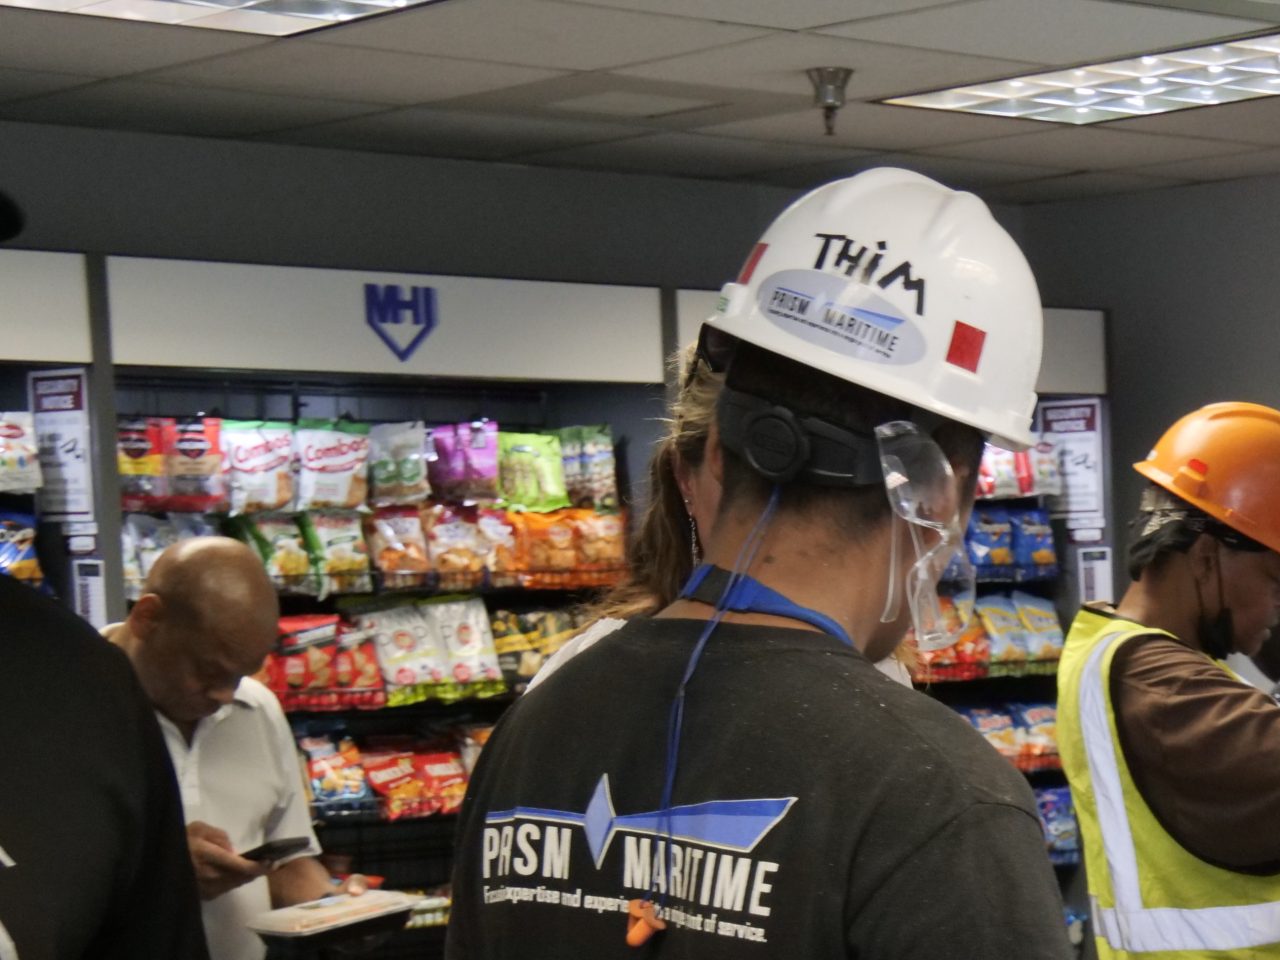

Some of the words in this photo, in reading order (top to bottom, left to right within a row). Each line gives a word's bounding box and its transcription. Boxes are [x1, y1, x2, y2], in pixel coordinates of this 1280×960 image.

[769, 290, 811, 316] PRISM
[823, 307, 899, 352] MARITIME
[234, 433, 292, 463] Combos
[304, 436, 368, 463] Combos
[623, 835, 780, 917] MARITIME
